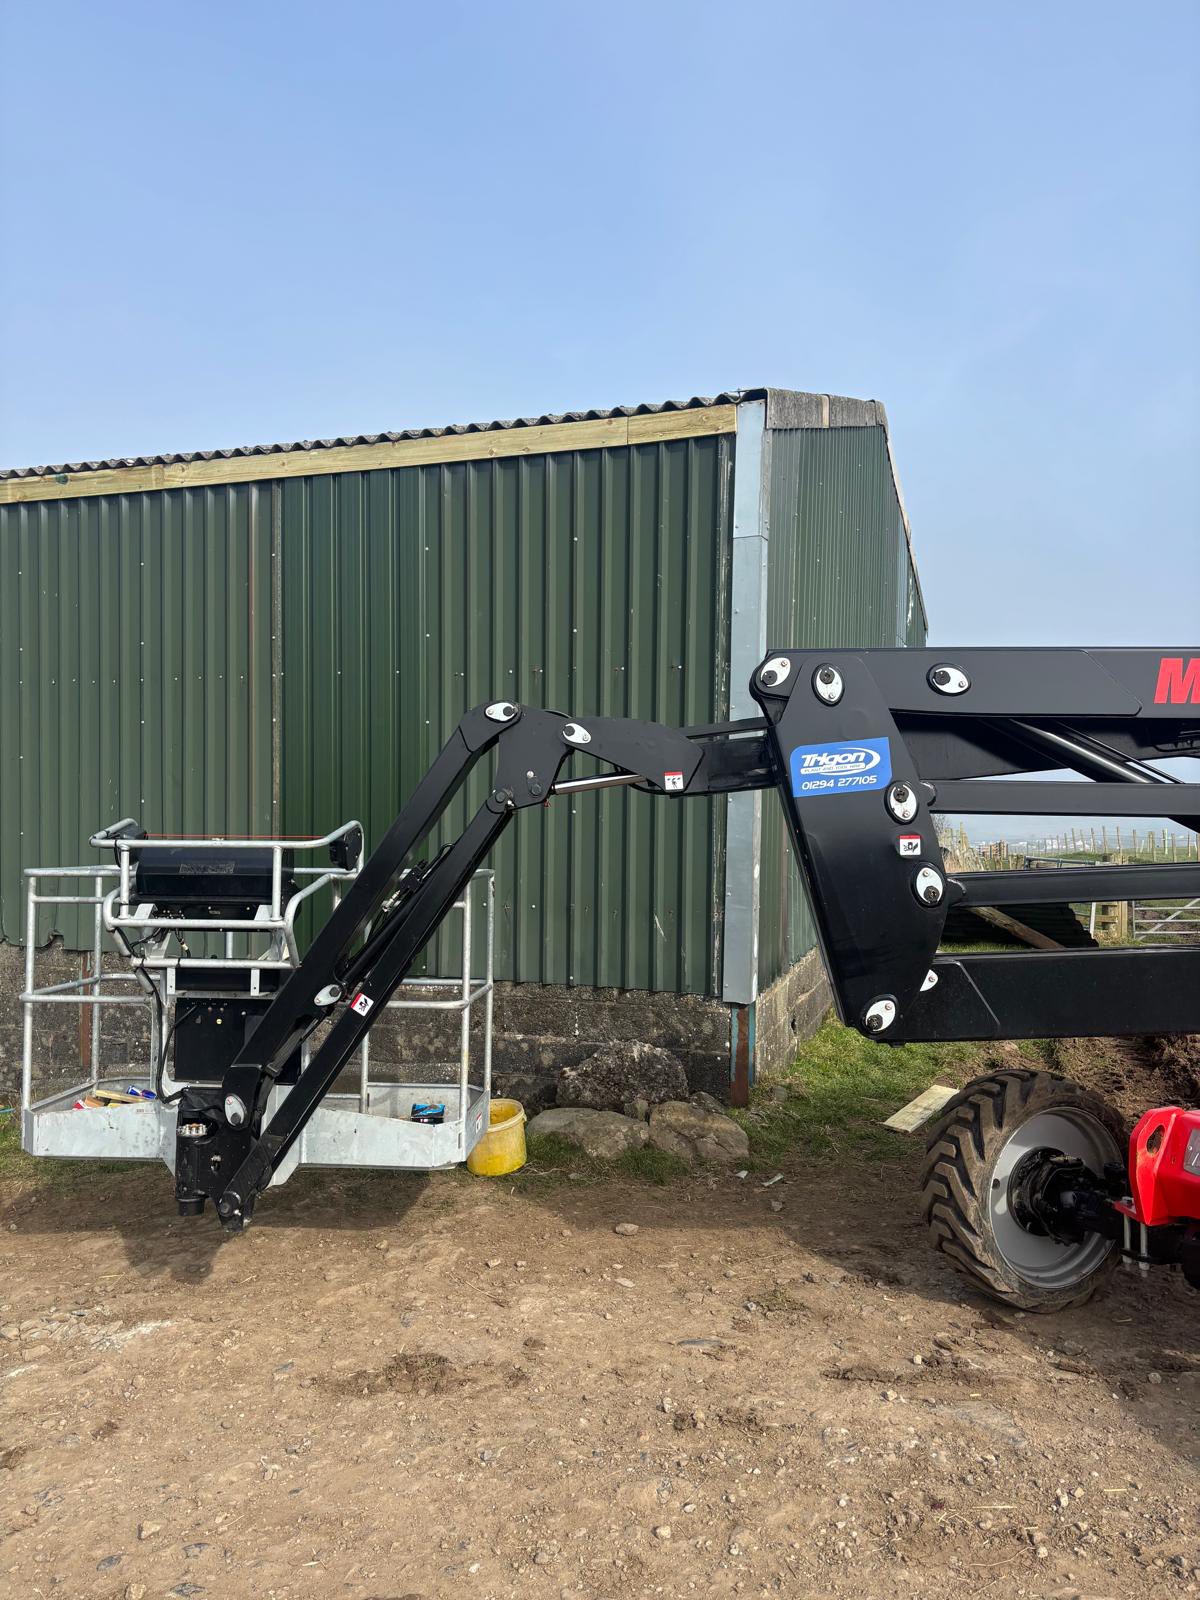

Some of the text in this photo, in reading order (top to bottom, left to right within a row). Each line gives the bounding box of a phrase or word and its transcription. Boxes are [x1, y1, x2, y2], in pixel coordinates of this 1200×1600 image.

[1153, 657, 1200, 704] M
[802, 752, 866, 767] Trigon
[802, 775, 878, 790] 01294 277105
